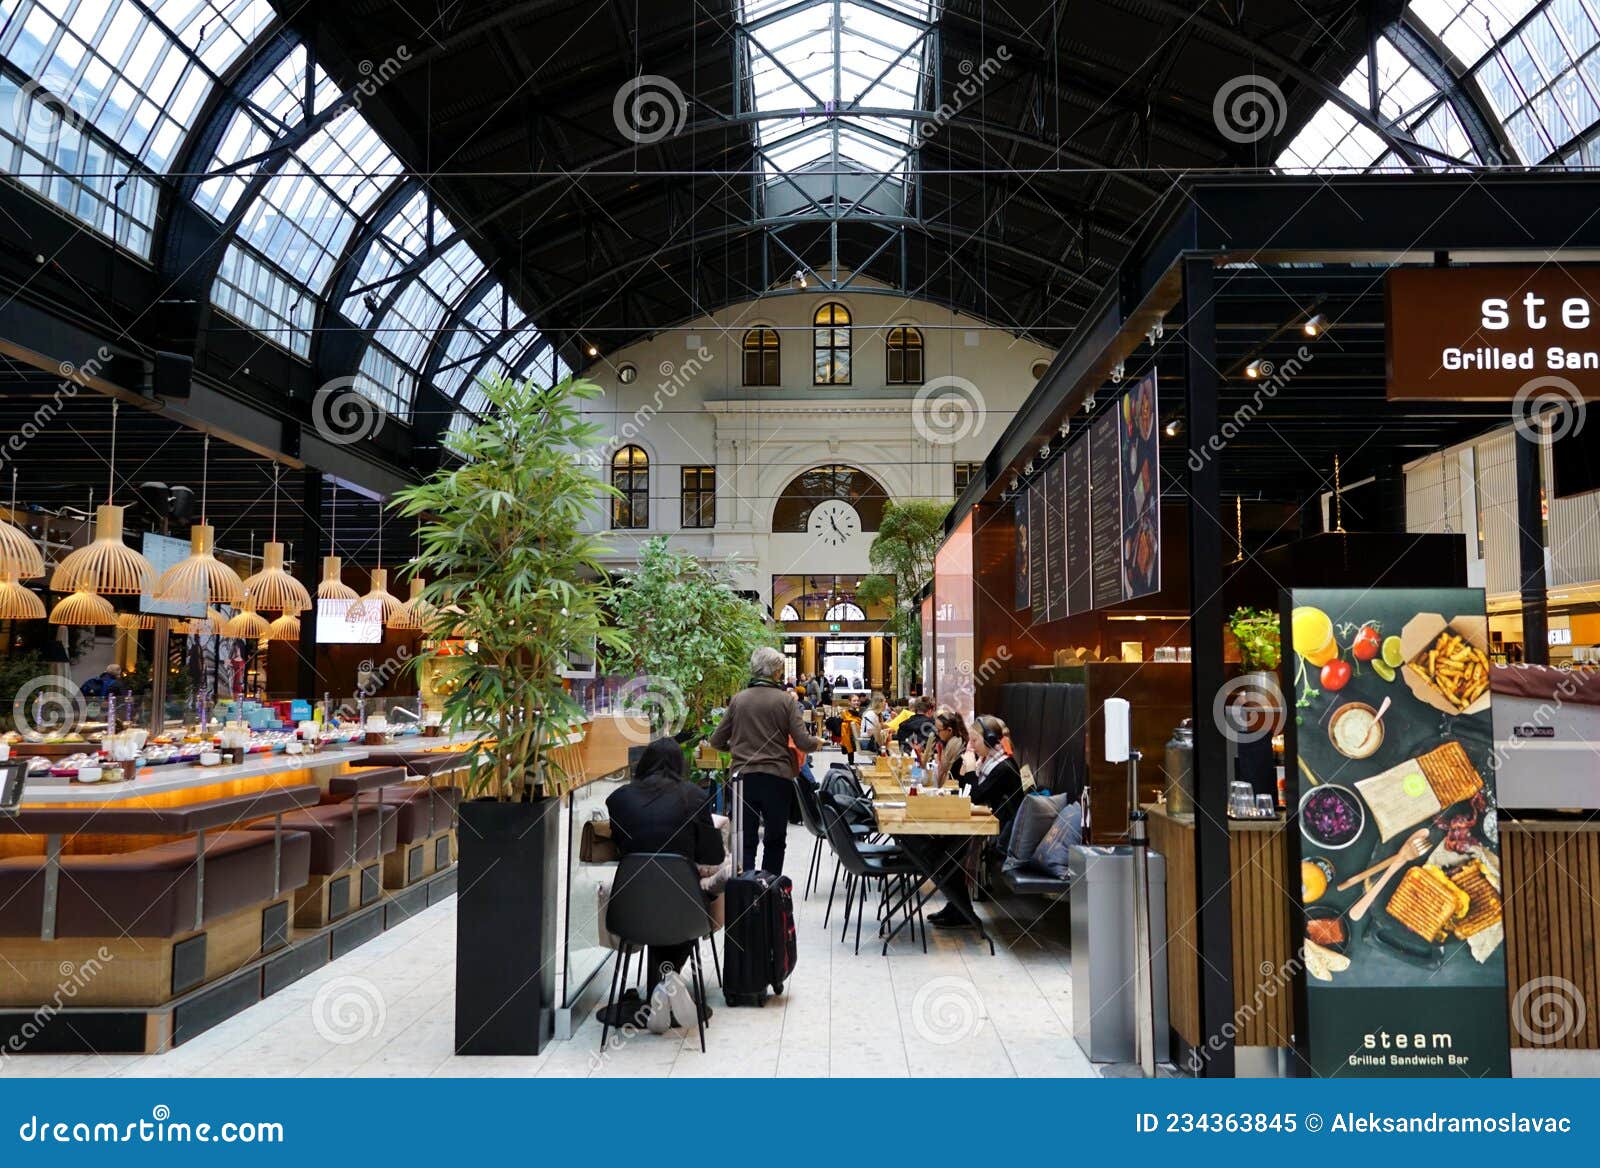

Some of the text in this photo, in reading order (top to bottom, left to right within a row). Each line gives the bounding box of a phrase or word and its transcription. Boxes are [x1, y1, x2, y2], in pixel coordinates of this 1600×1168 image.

[1442, 346, 1534, 370] Grilled
[1363, 1031, 1453, 1049] steam
[1348, 1054, 1469, 1066] Grilled Sandwich Bar
